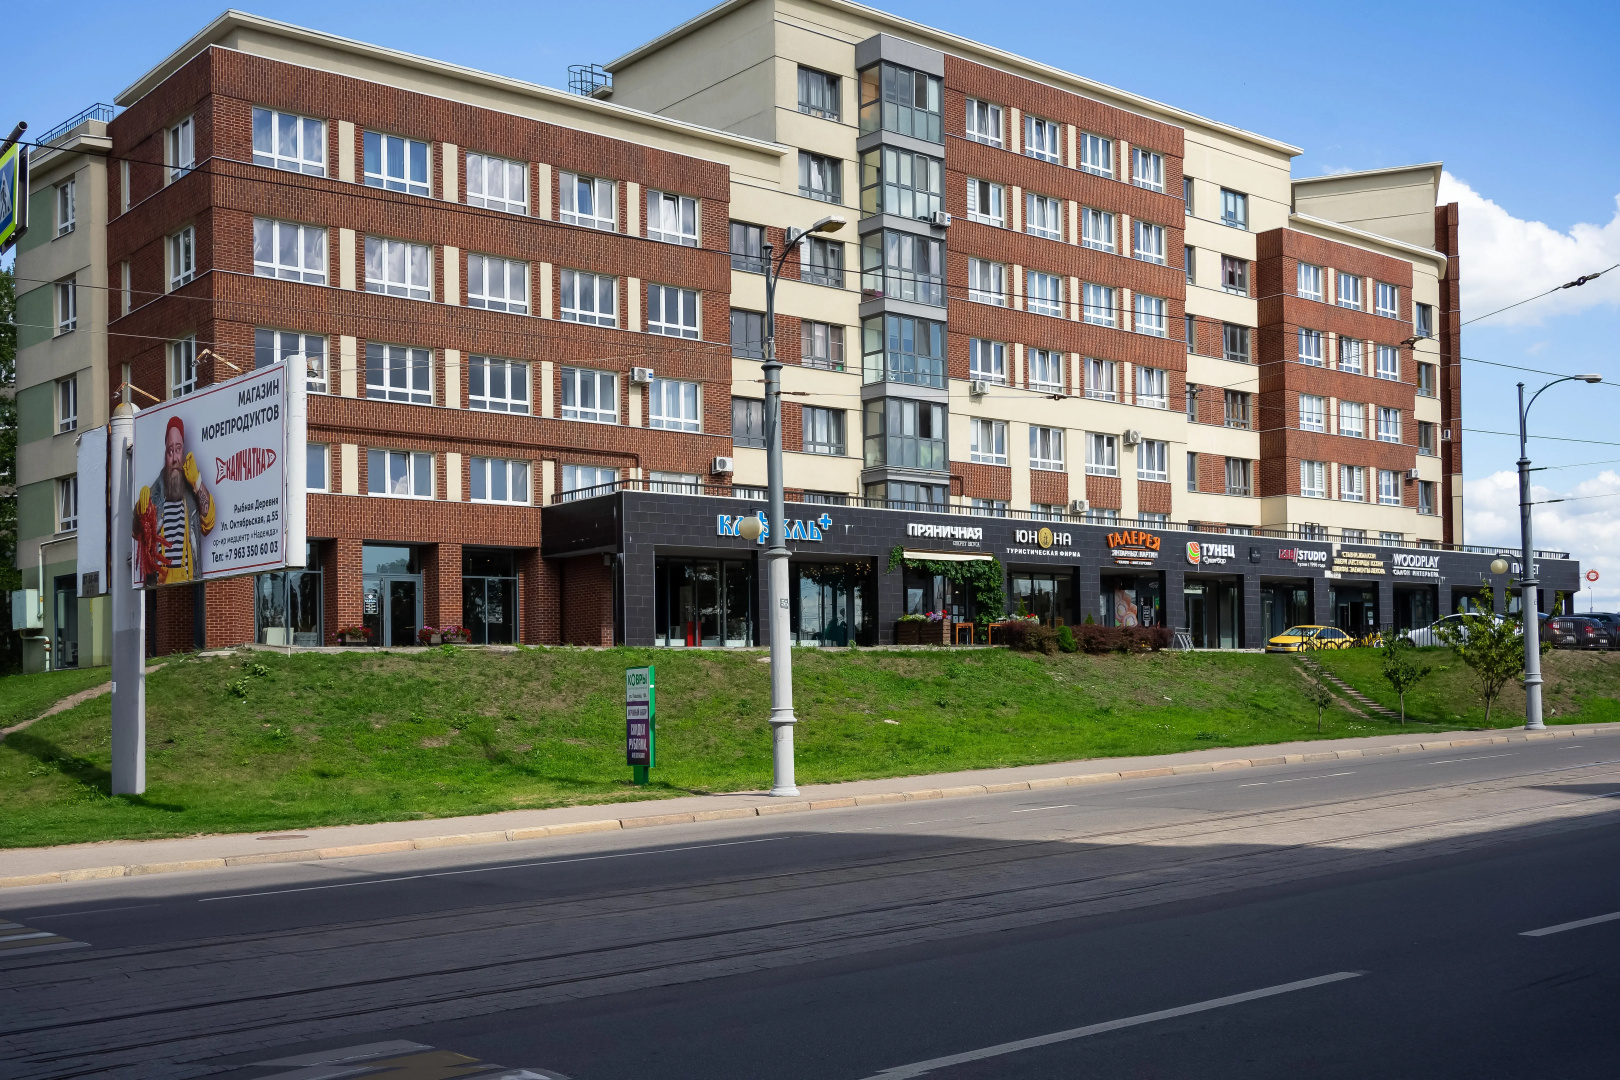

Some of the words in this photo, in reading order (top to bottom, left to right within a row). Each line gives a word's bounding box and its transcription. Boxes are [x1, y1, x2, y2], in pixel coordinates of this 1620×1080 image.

[238, 379, 279, 407] МАГАЗИН
[202, 404, 279, 442] МОРЕПРОДУКТОВ
[225, 448, 266, 482] КАМЧАТКА
[234, 502, 254, 514] Рыбная
[255, 497, 278, 511] Деревня
[907, 523, 982, 540] ПРЯНИЧНАЯ
[1107, 531, 1160, 551] ГАЛЕРЕЯ
[234, 547, 245, 559] 963
[247, 544, 258, 557] 350
[260, 543, 268, 554] 60
[270, 541, 278, 553] 03
[1007, 548, 1058, 556] ТУРИСТИЧЕСКАЯ
[1201, 543, 1235, 558] ТУНЕЦ
[1298, 550, 1326, 561] STUDIO
[1392, 553, 1440, 568] WOODPLAY
[628, 674, 647, 686] КОВРЫ
